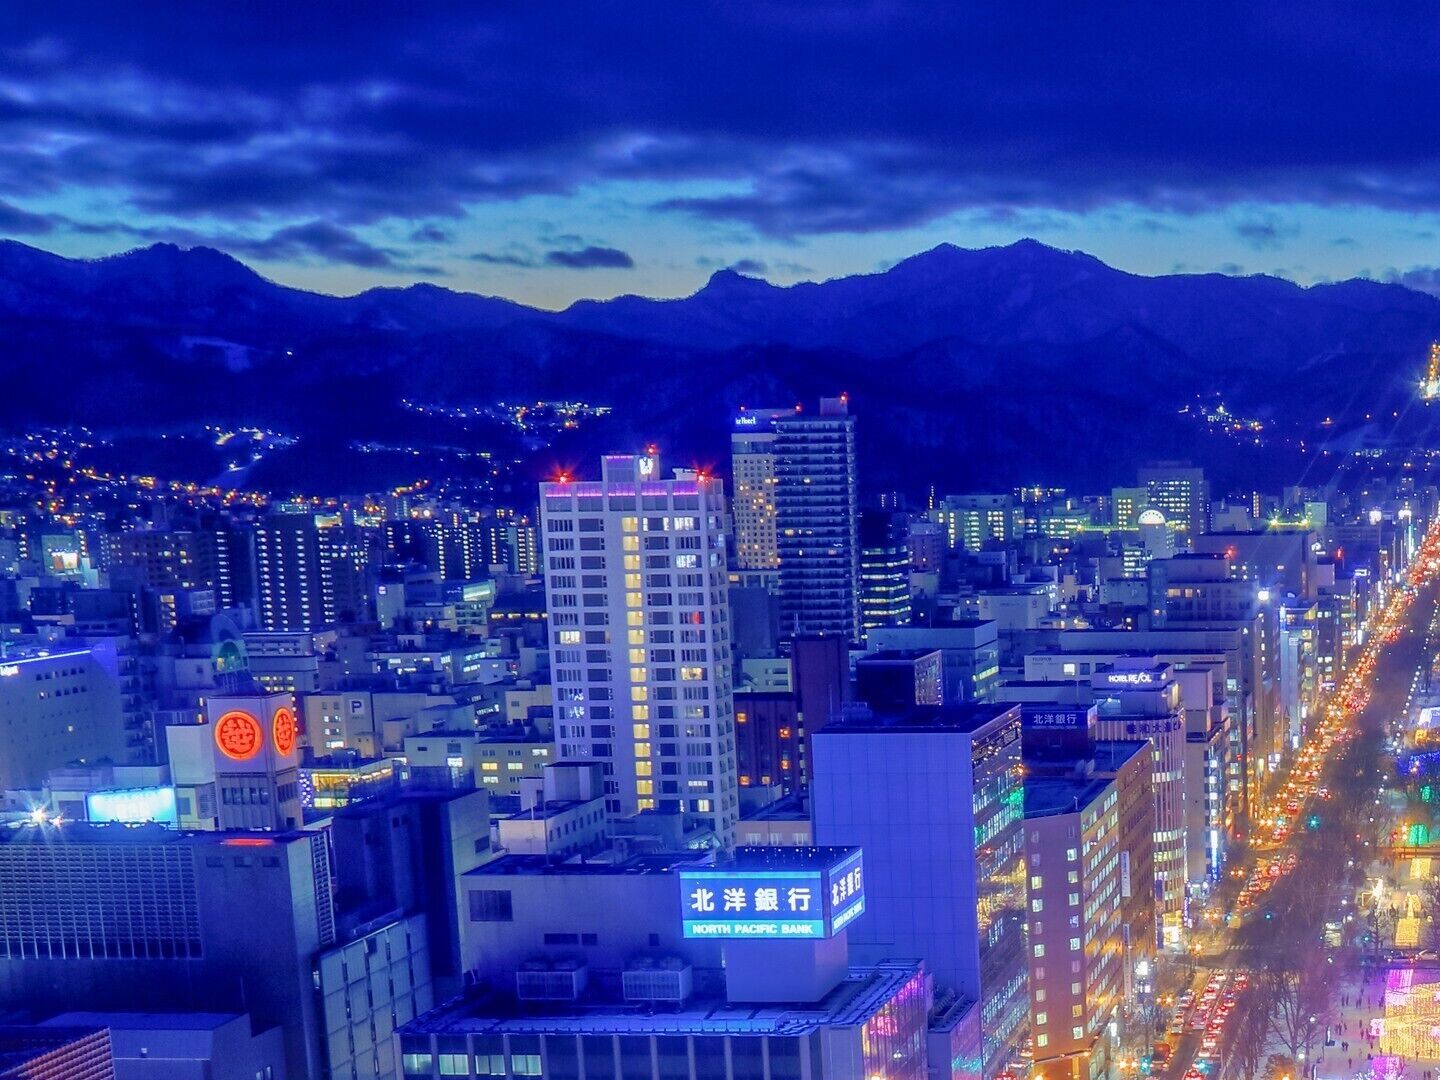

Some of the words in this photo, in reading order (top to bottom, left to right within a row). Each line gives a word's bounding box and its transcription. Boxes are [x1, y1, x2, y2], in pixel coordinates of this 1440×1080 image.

[1033, 713, 1077, 725] 北洋銀行
[832, 867, 861, 906] 北洋銀行
[691, 888, 811, 912] 北洋銀行
[692, 924, 731, 935] NORTH
[734, 924, 777, 935] PACIFIC
[781, 924, 813, 935] BANK
